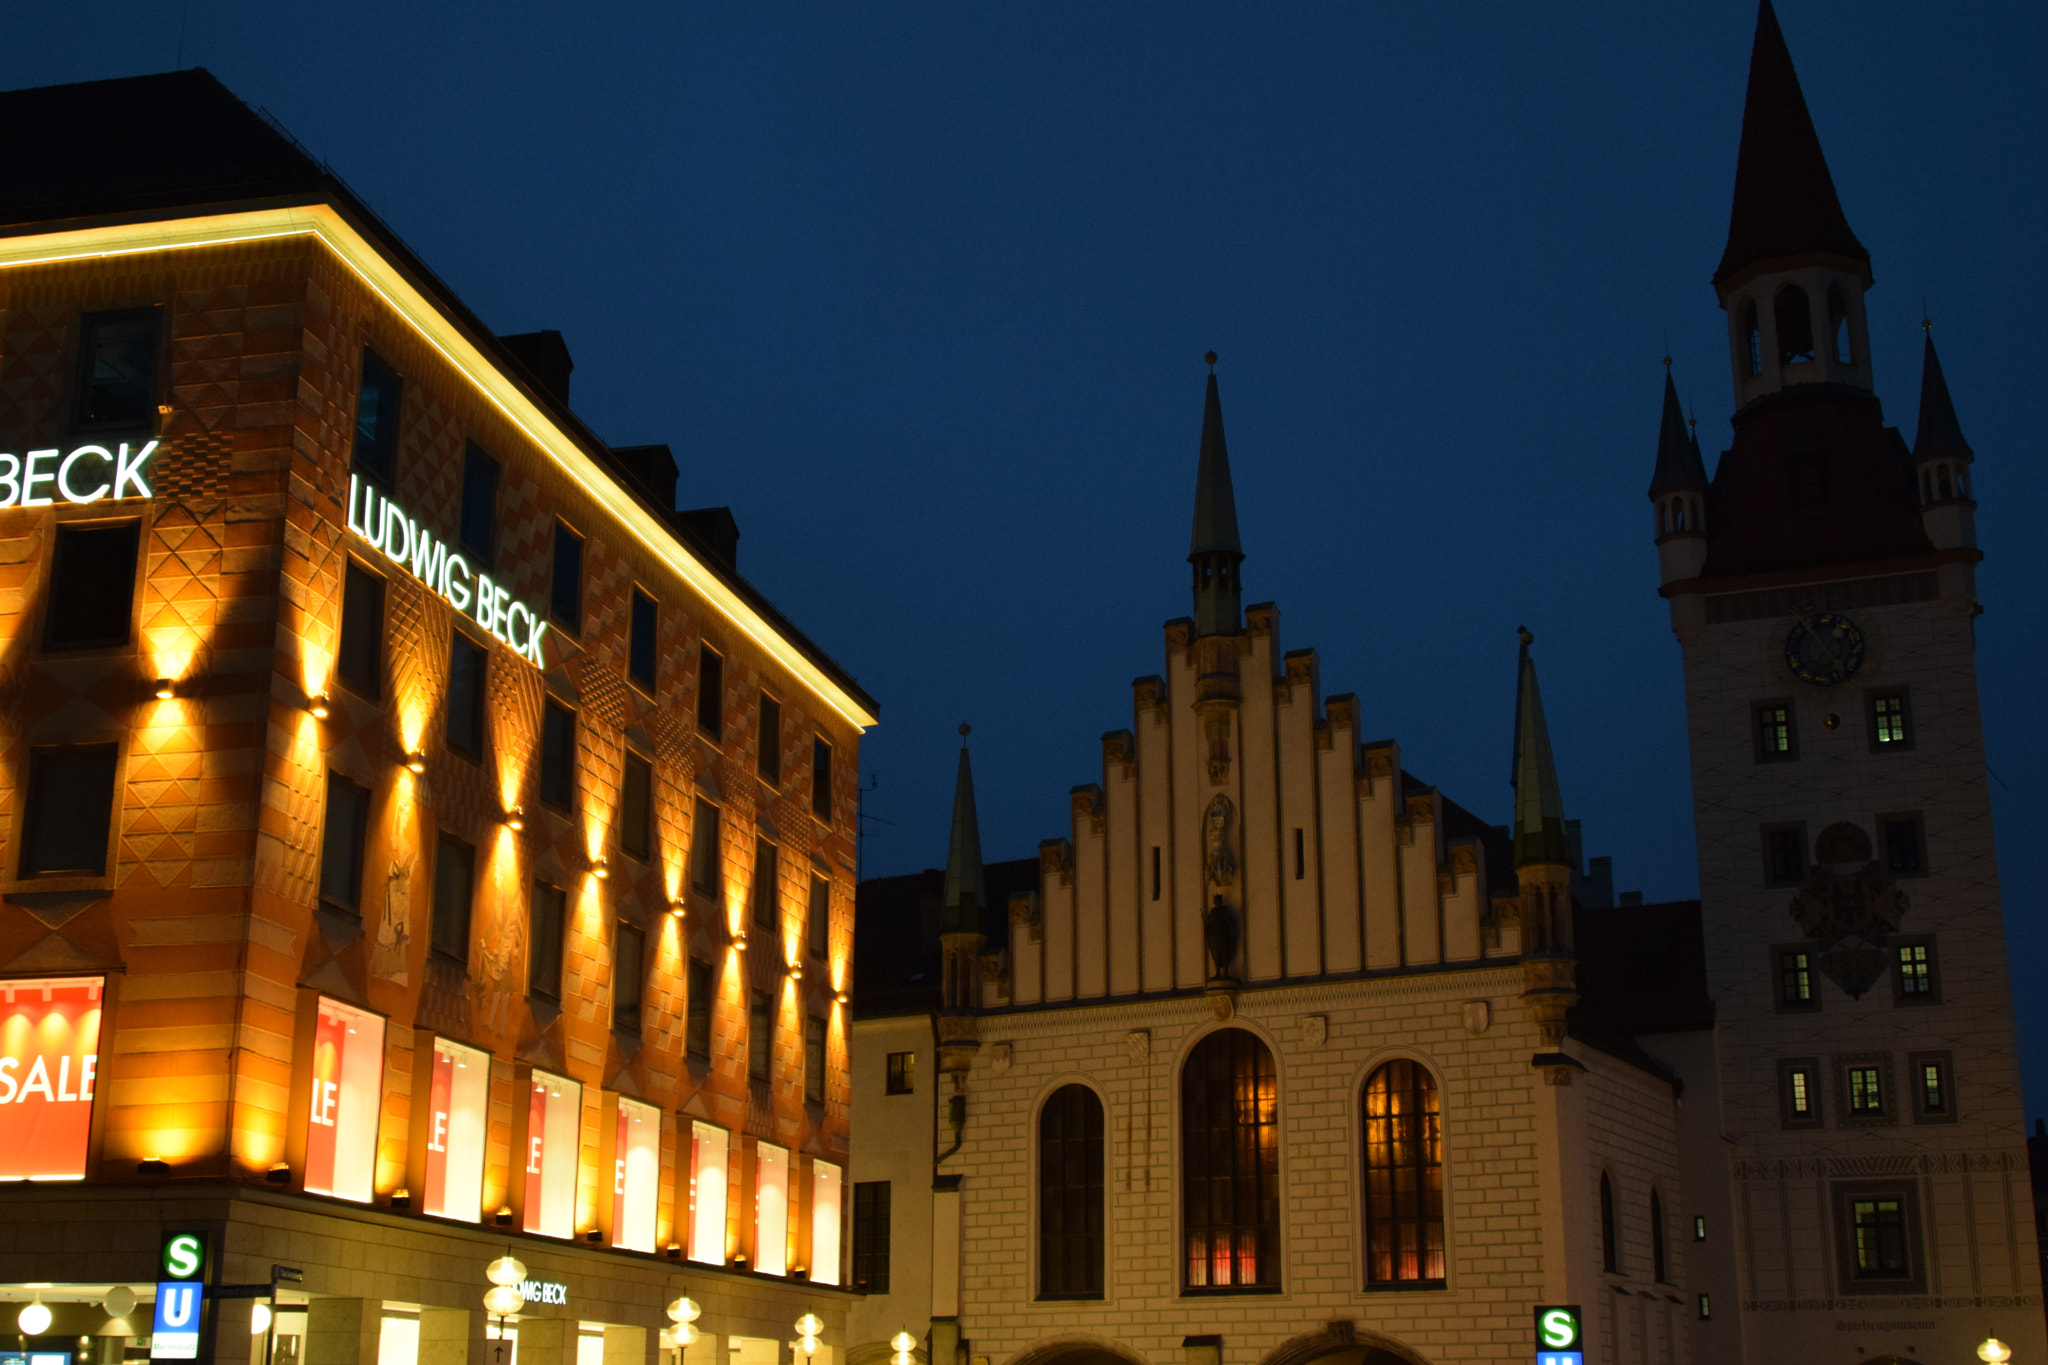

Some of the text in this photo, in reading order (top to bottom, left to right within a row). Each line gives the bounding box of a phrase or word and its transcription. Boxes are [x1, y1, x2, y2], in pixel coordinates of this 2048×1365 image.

[0, 440, 159, 509] BECK
[347, 473, 547, 670] LUDWIG BECK
[0, 1054, 98, 1104] SALE
[168, 1237, 198, 1276] S
[163, 1288, 193, 1327] U
[542, 1282, 567, 1305] BECK
[1544, 1311, 1573, 1347] S
